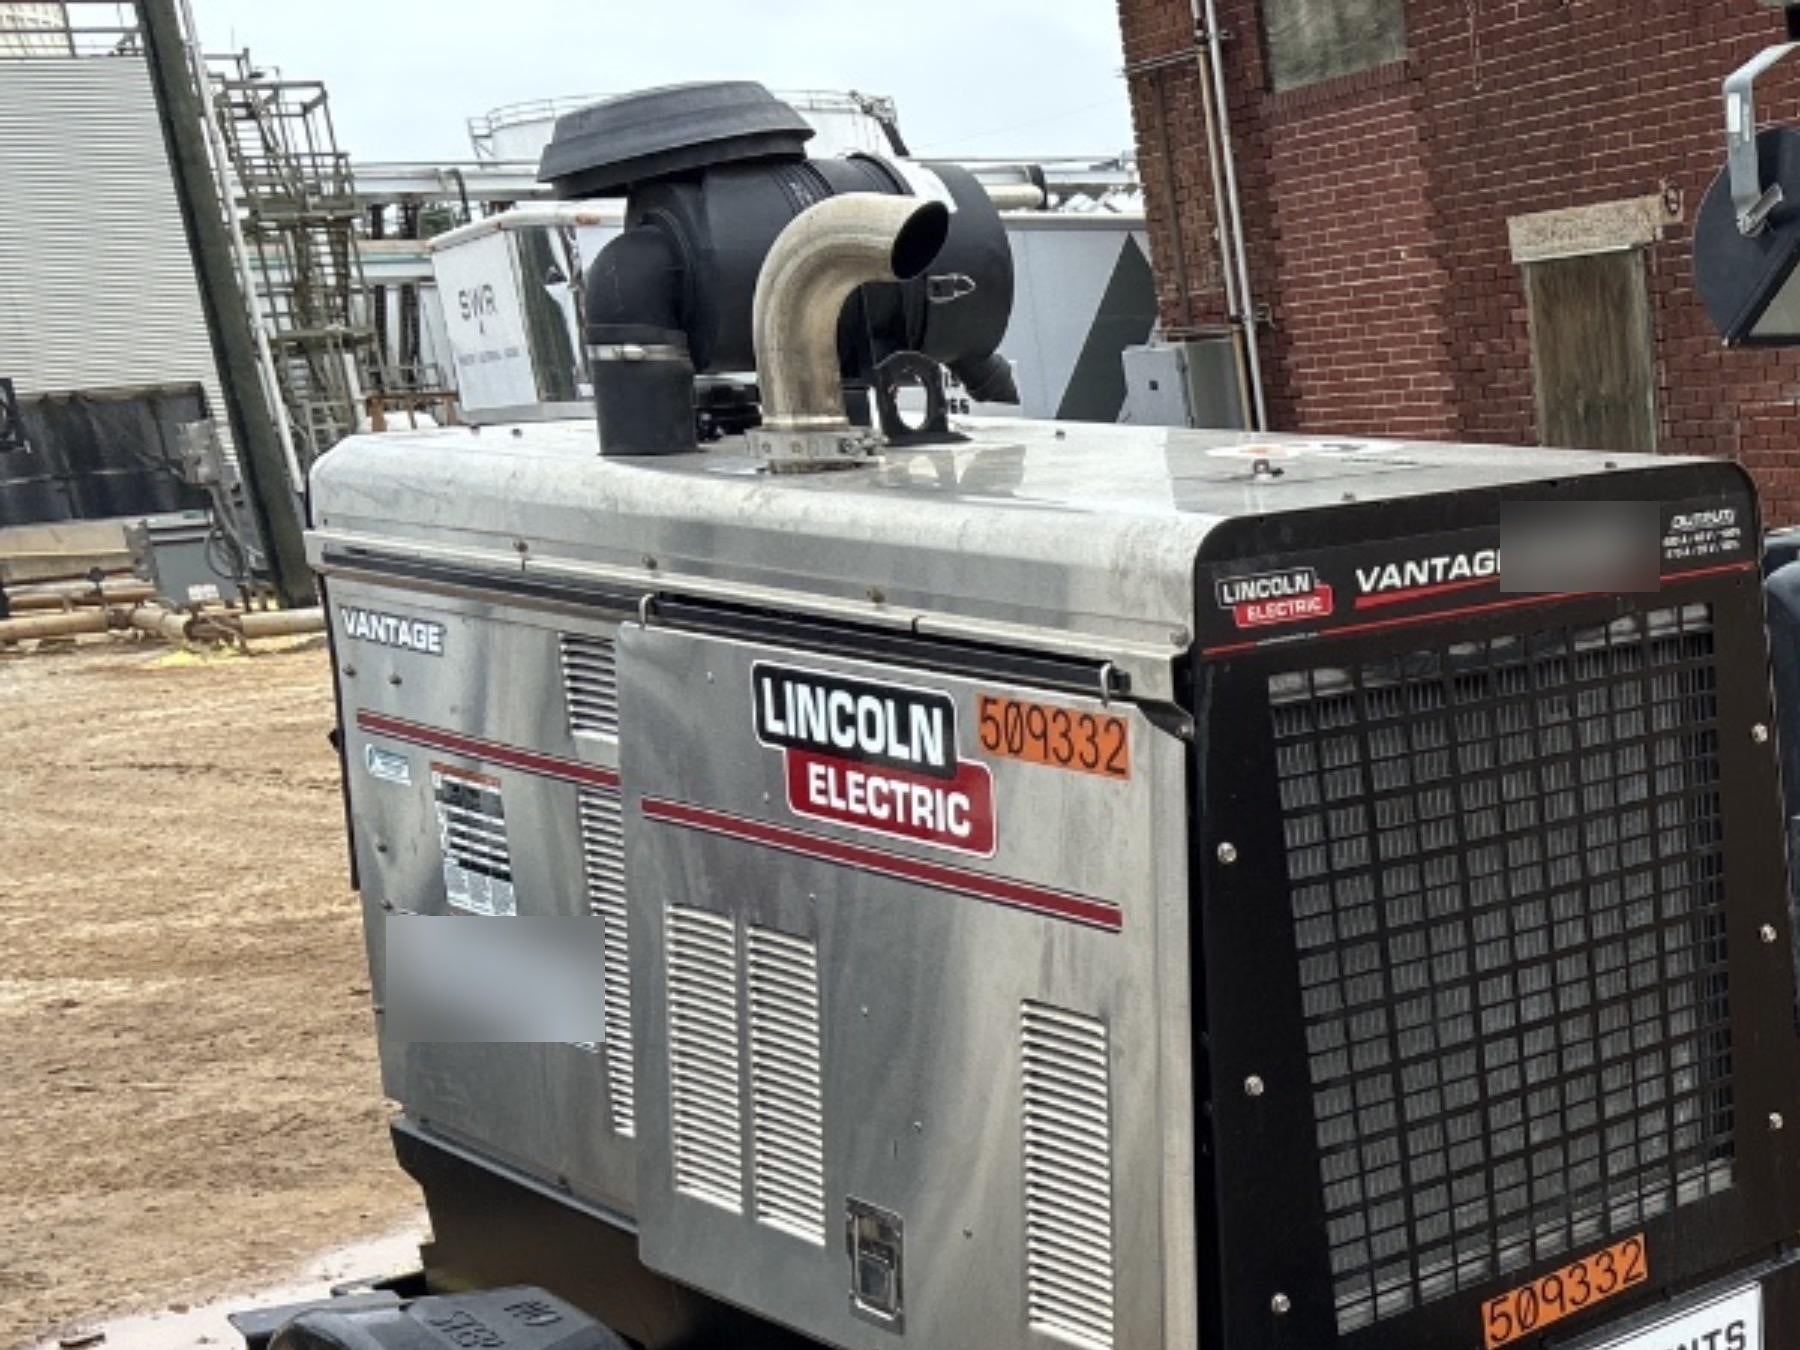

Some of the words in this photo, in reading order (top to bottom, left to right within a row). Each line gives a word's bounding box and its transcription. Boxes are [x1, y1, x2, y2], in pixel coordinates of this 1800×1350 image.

[1222, 572, 1310, 604] LINCOLN
[1355, 547, 1500, 593] VANTAG
[341, 607, 445, 654] VANTAGE
[1247, 597, 1323, 621] ELECTRIC
[761, 676, 945, 767] LINCOLN
[980, 696, 1127, 774] 509332
[807, 763, 971, 838] ELECTRIC
[1486, 1238, 1645, 1342] 509332
